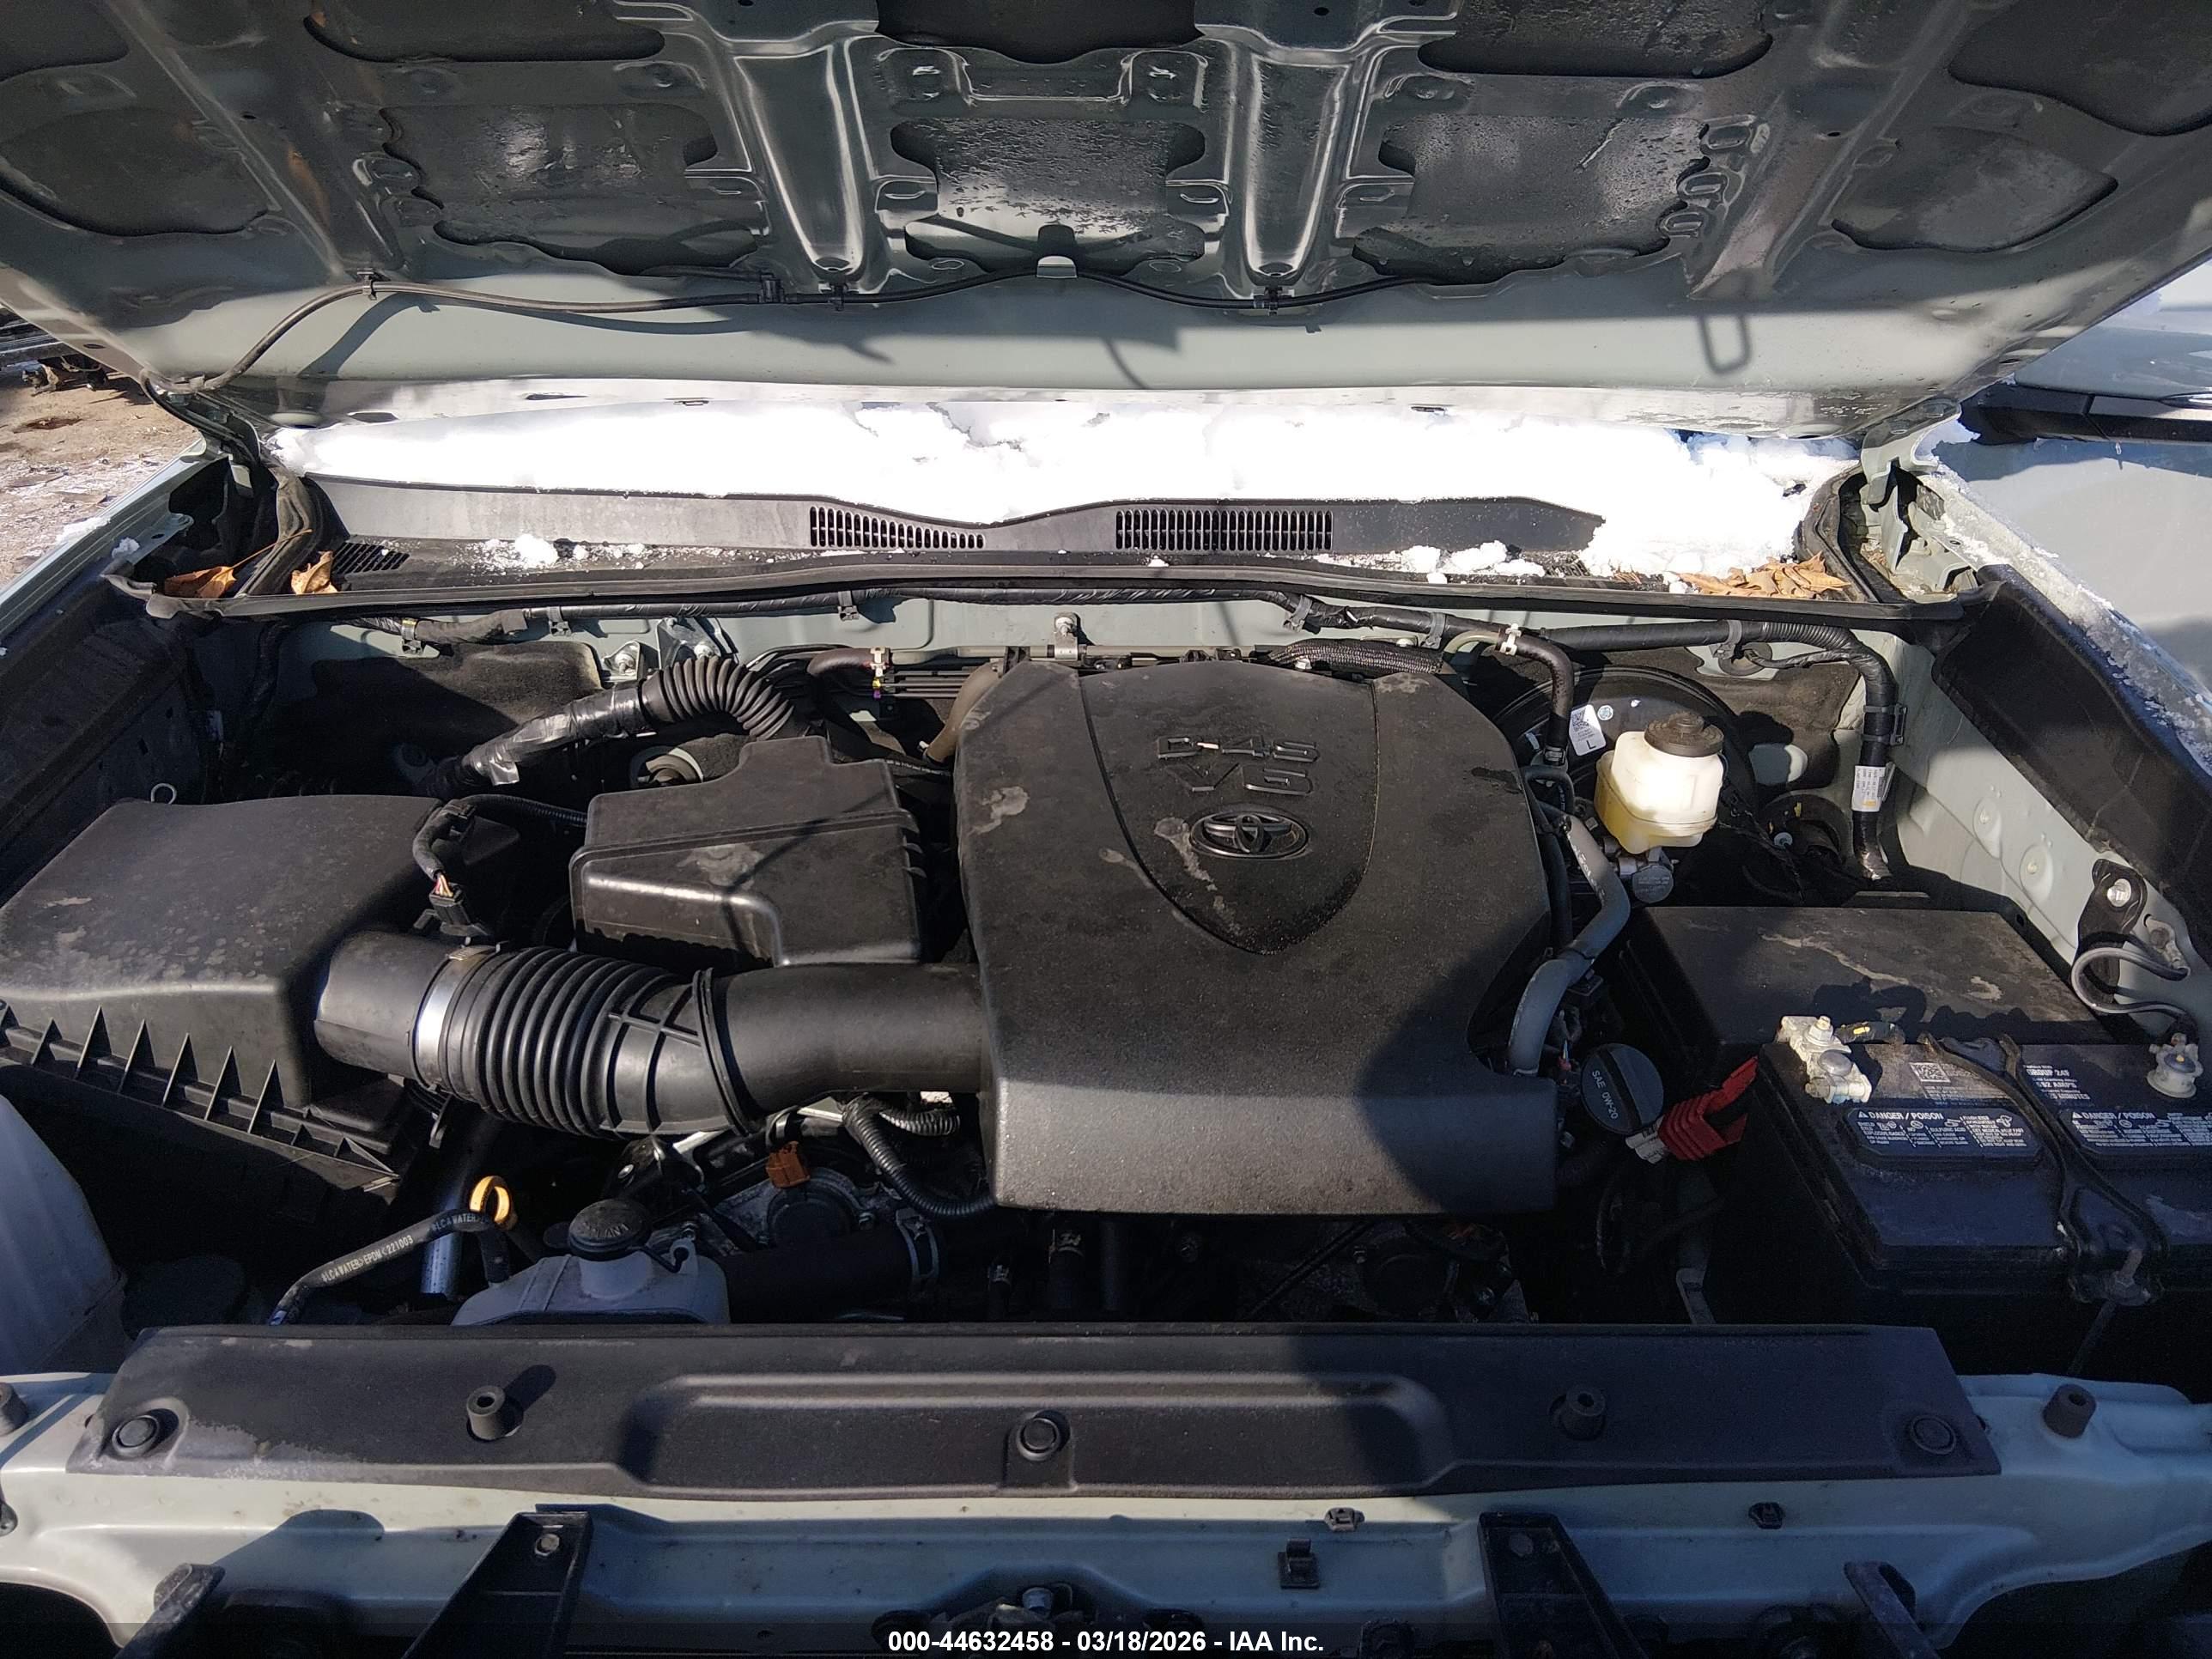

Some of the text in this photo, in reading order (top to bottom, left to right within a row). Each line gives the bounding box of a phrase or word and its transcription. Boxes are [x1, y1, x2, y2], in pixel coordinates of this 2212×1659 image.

[1586, 739, 1597, 750] L
[1592, 1070, 1619, 1120] SAE 0W-20
